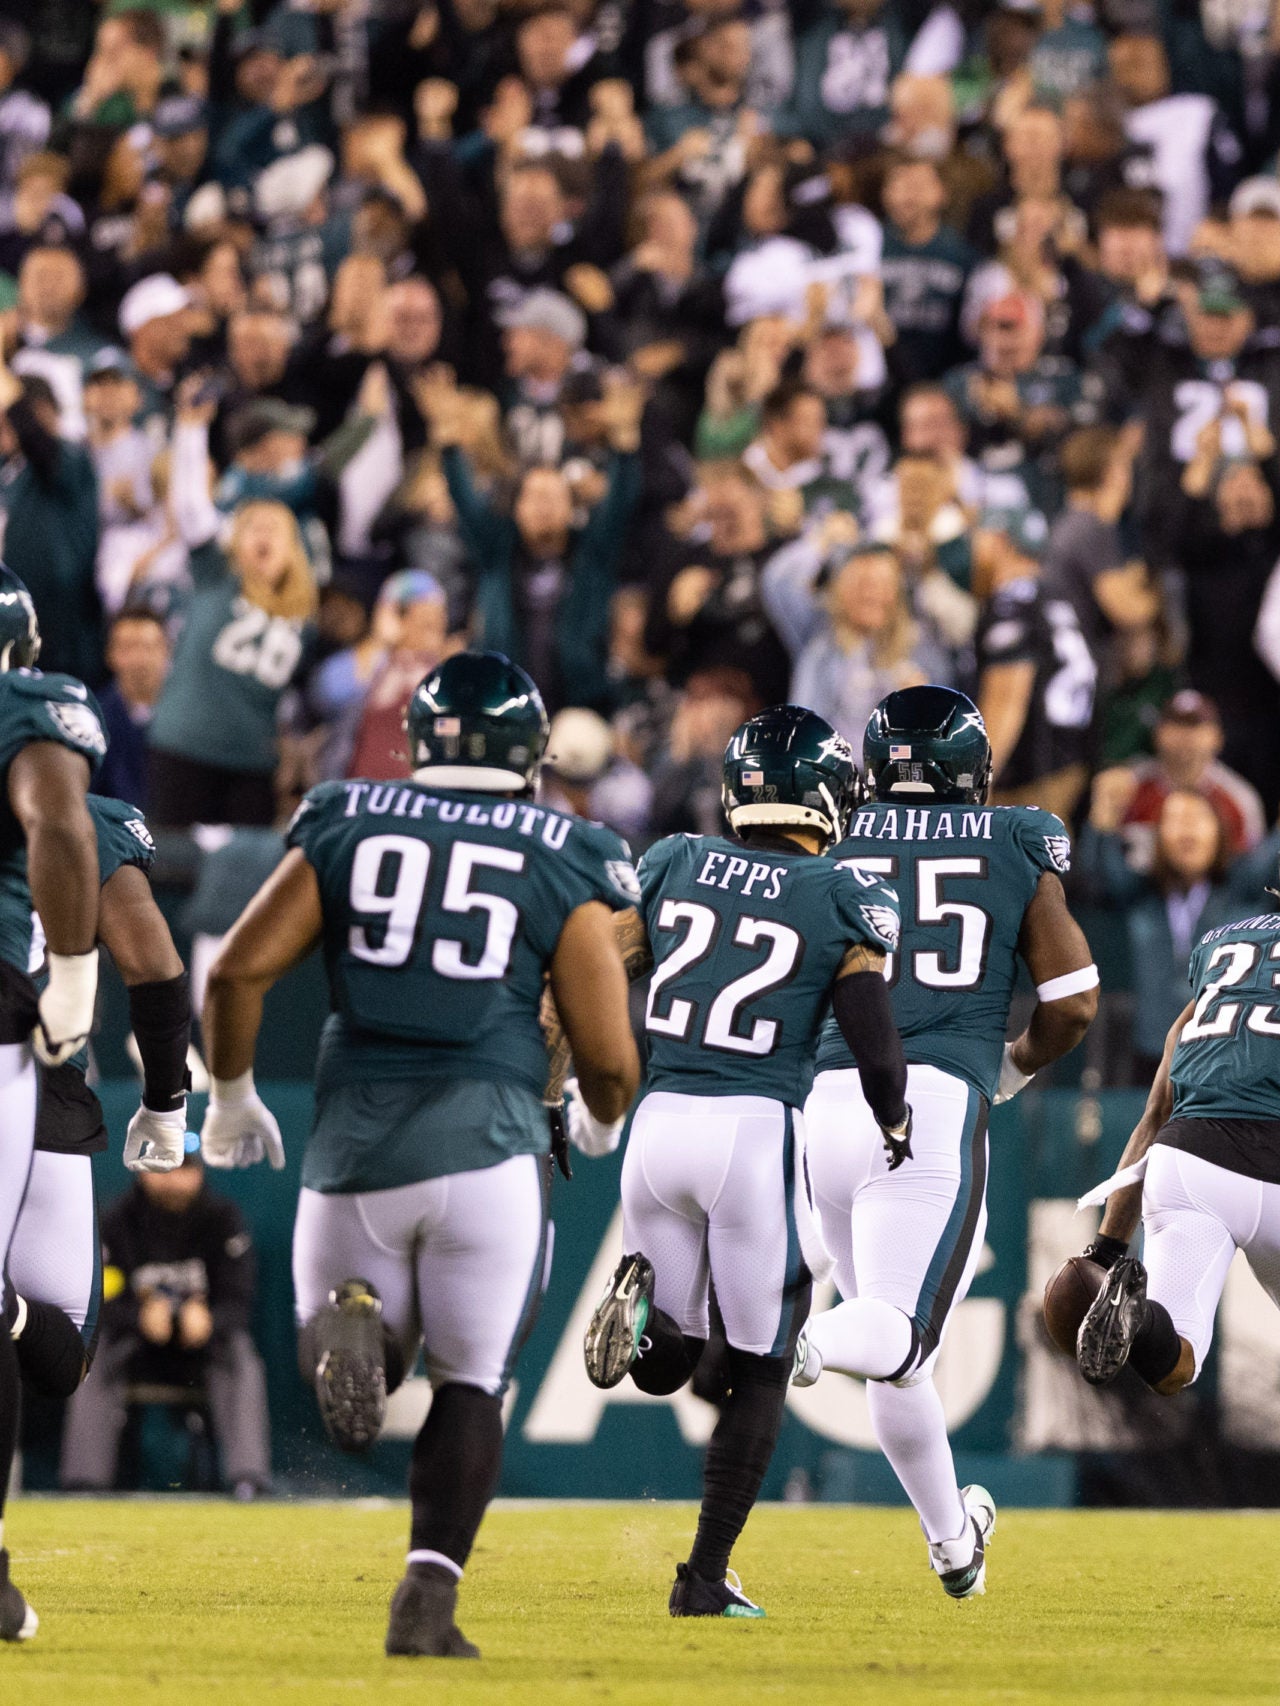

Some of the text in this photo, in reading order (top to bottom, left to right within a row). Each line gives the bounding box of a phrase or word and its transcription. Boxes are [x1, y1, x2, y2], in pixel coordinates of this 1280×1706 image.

[898, 762, 925, 783] 55
[850, 808, 994, 841] RAHAM
[348, 834, 525, 981] 95
[696, 851, 789, 900] EPPS
[838, 858, 988, 987] 5
[645, 900, 800, 1056] 22
